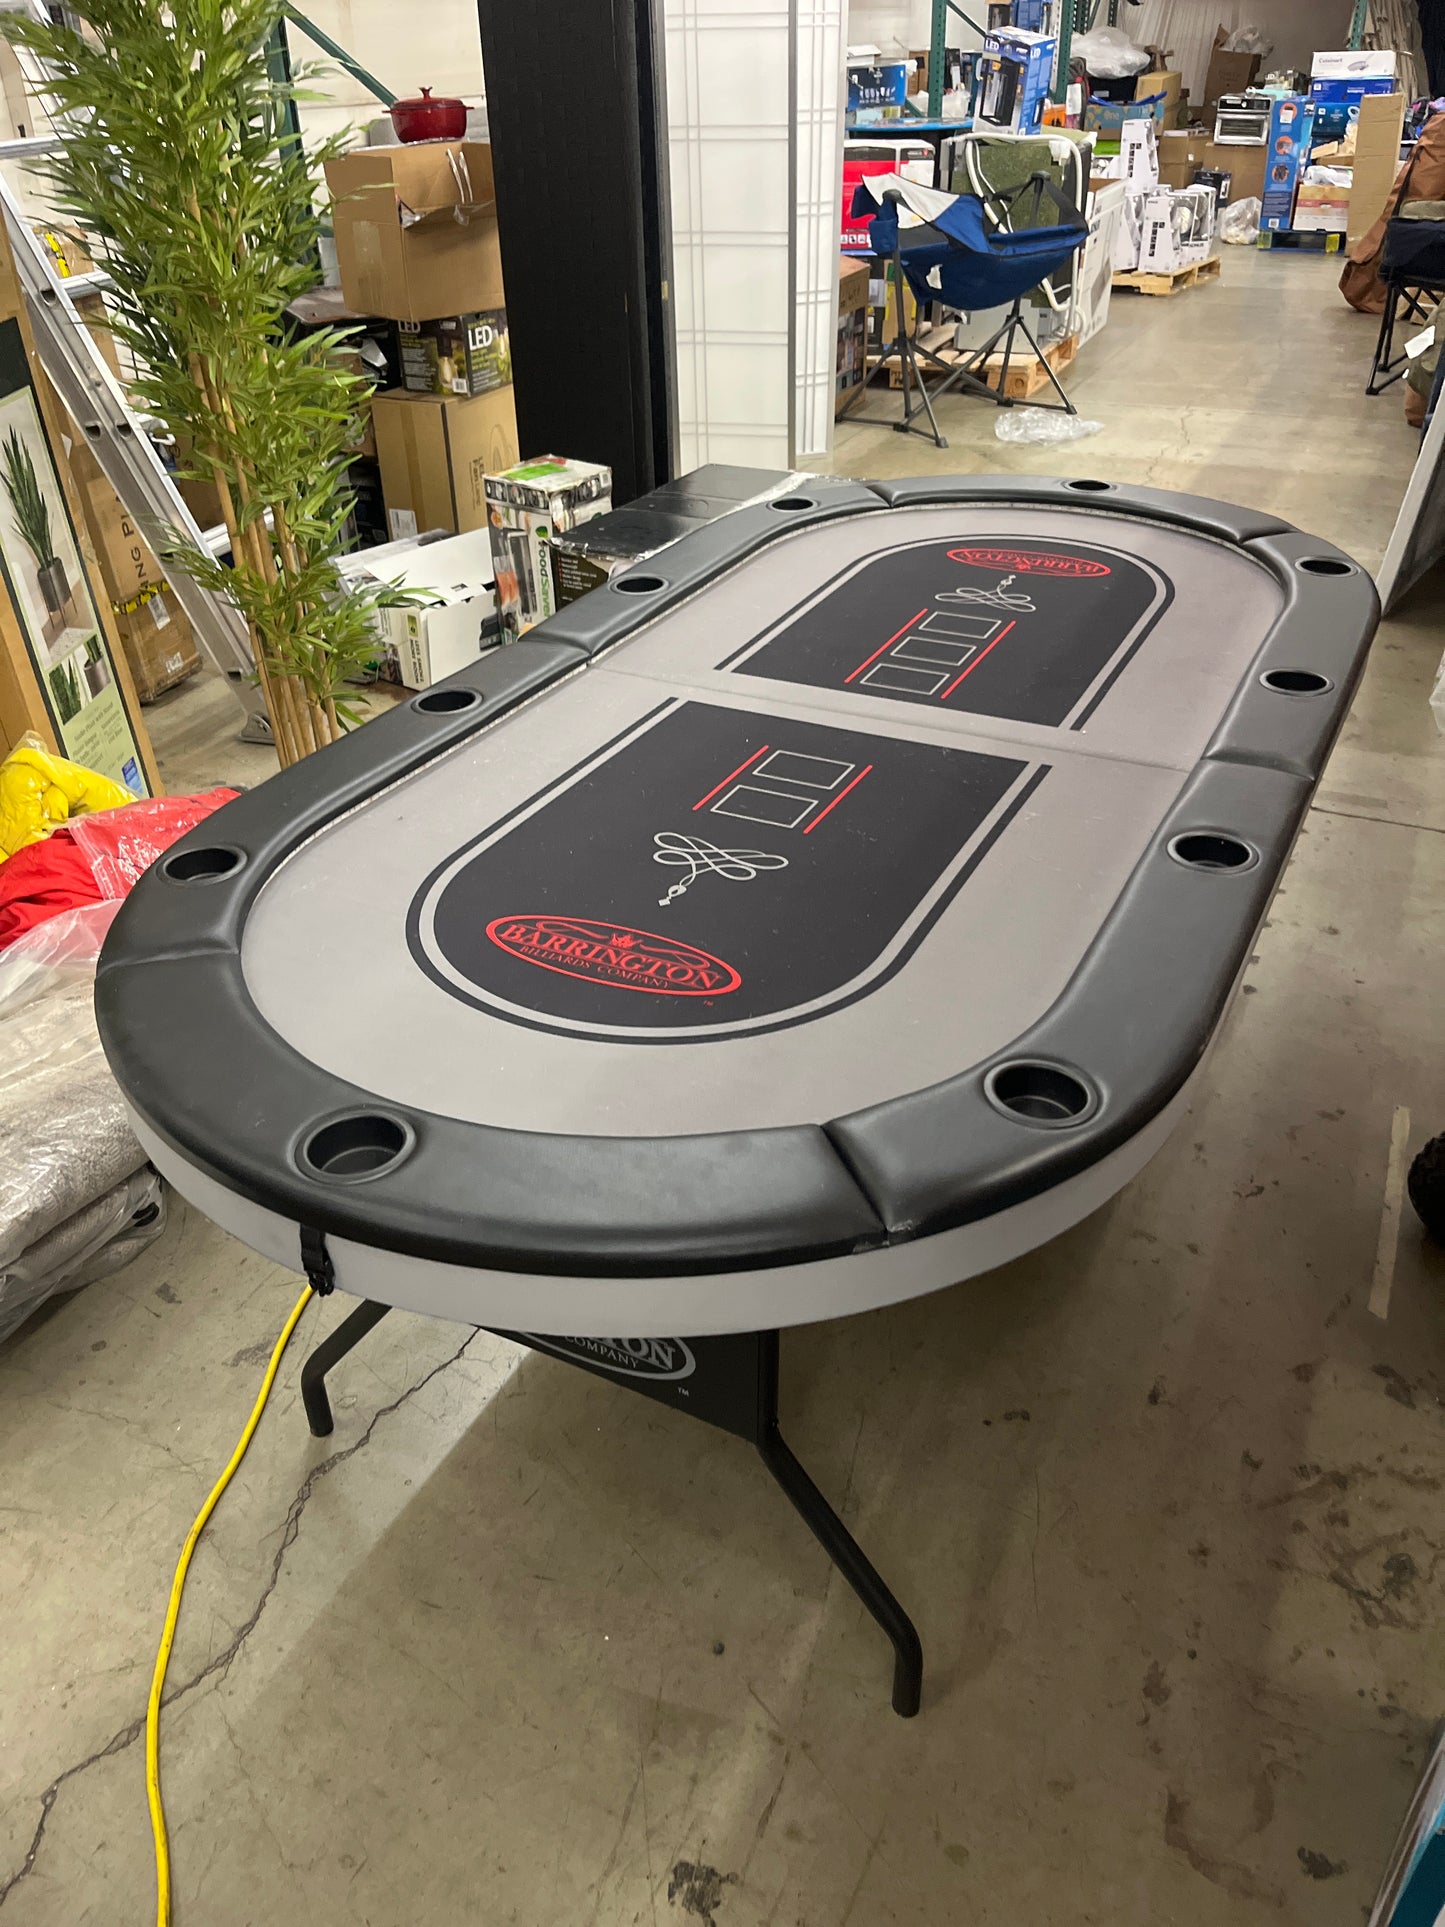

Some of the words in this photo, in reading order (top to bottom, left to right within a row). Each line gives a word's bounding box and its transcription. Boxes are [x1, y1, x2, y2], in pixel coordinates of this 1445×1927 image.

[398, 320, 421, 333] LED
[468, 325, 493, 351] LED
[537, 541, 550, 618] oodSaver
[501, 923, 723, 989] BARRINGTON
[518, 943, 591, 969] BILLIARDS
[596, 965, 670, 990] COMPANY
[564, 1336, 640, 1369] COMPANY
[677, 1387, 690, 1398] TM
